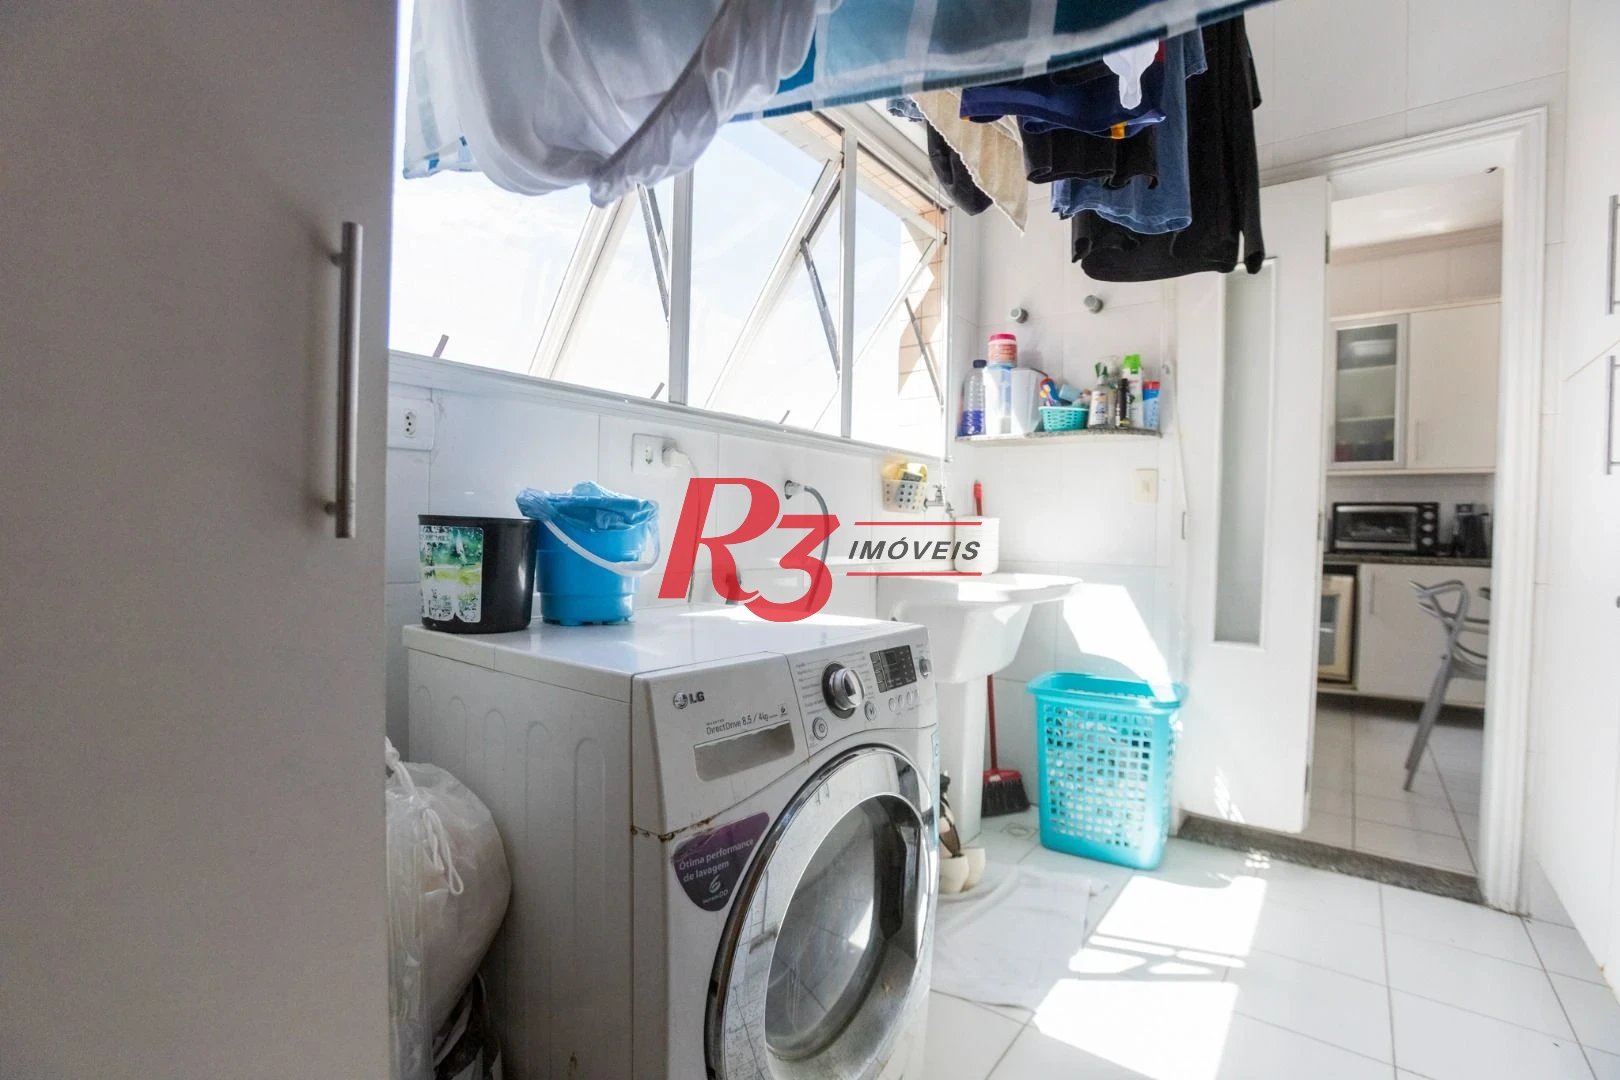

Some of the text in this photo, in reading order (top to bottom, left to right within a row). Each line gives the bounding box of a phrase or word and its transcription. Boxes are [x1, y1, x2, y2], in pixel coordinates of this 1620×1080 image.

[689, 691, 705, 704] LG
[706, 839, 754, 863] performance
[683, 861, 729, 882] de lavagem
